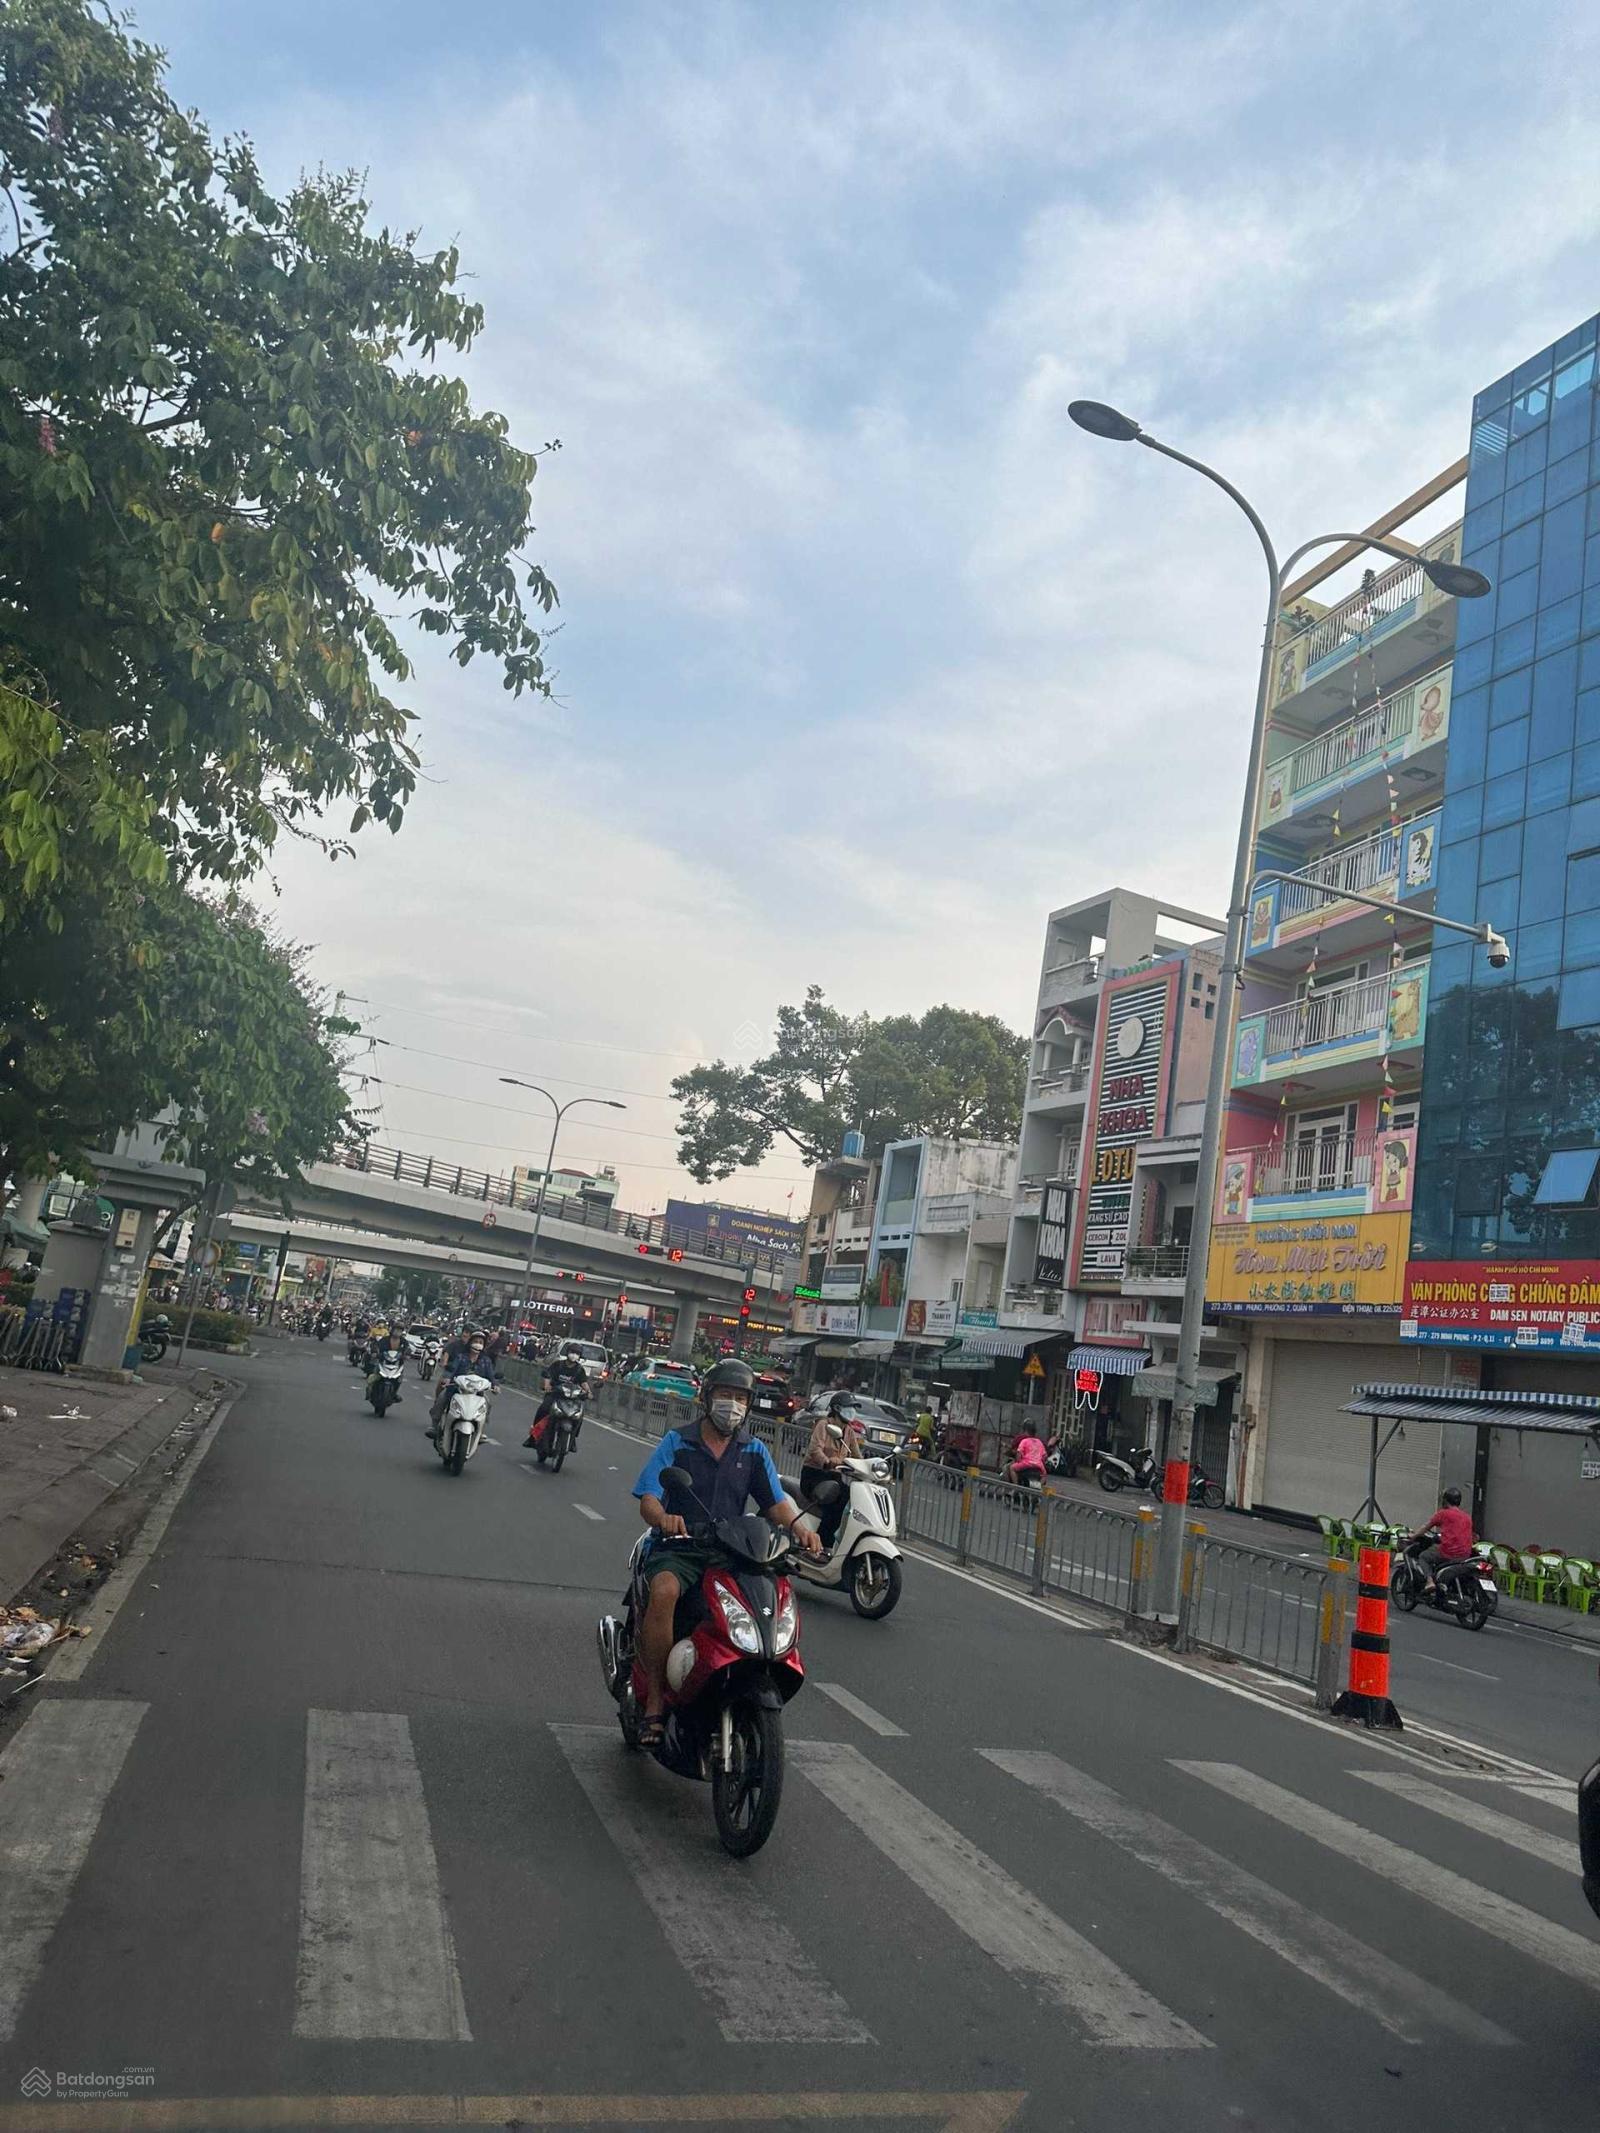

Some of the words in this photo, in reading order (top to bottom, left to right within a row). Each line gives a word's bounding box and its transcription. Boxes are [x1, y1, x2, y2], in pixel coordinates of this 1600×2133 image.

[1109, 1075, 1144, 1099] NHA
[1099, 1106, 1148, 1134] KHOA
[1045, 1188, 1067, 1224] NHA
[1039, 1223, 1066, 1260] KHOA
[671, 1250, 682, 1262] 12
[1100, 1255, 1117, 1263] LAVA
[745, 1290, 755, 1300] 12
[1411, 1279, 1431, 1300] VĂN
[1435, 1278, 1477, 1302] PHÒNG
[1480, 1279, 1517, 1303] CG
[1520, 1277, 1566, 1304] CHỨNG
[1570, 1276, 1600, 1304] ĐẦM
[523, 1300, 575, 1315] LOTTERIA
[1490, 1309, 1509, 1321] DAM
[1511, 1309, 1527, 1322] SEN
[1530, 1310, 1565, 1323] NOTARY
[1567, 1311, 1600, 1324] PUBLIC
